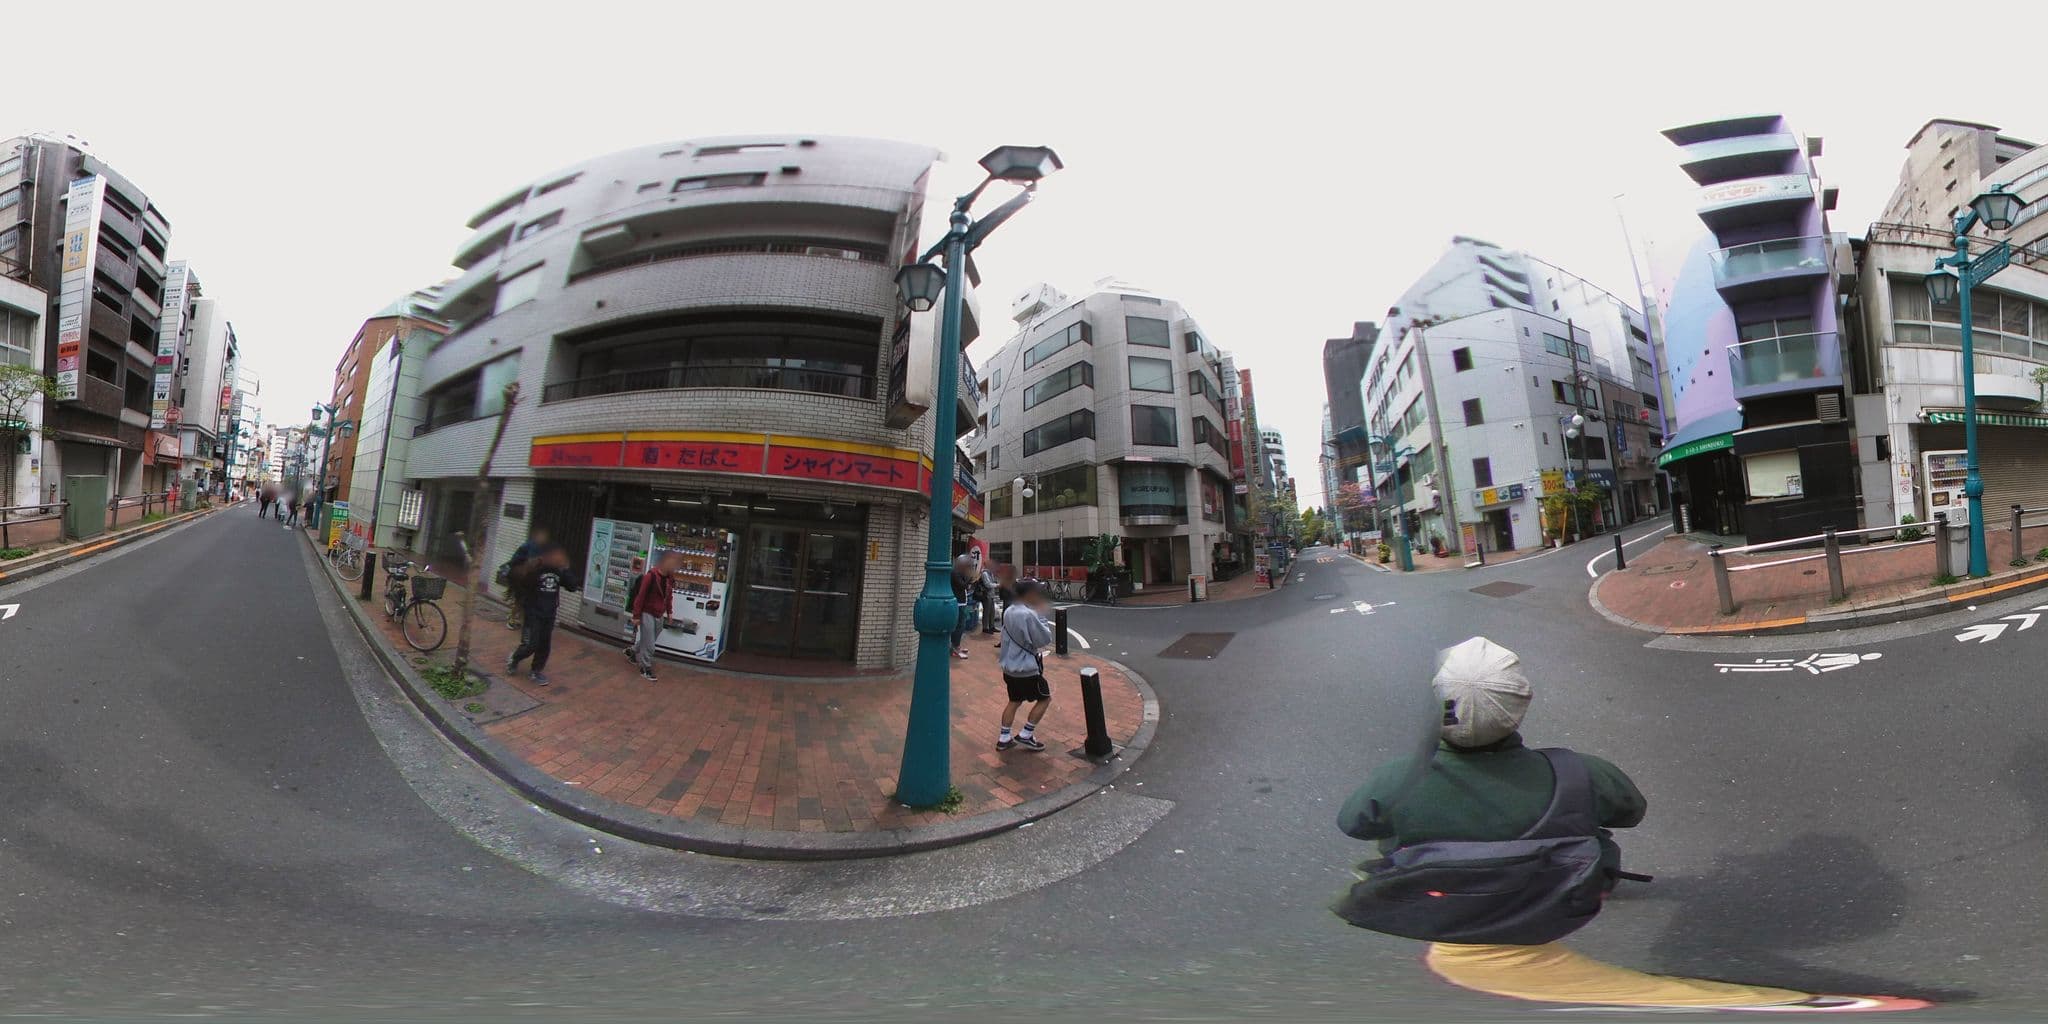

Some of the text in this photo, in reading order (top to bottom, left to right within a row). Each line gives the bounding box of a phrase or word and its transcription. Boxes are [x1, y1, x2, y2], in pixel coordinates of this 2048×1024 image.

[783, 454, 904, 482] シャインマート
